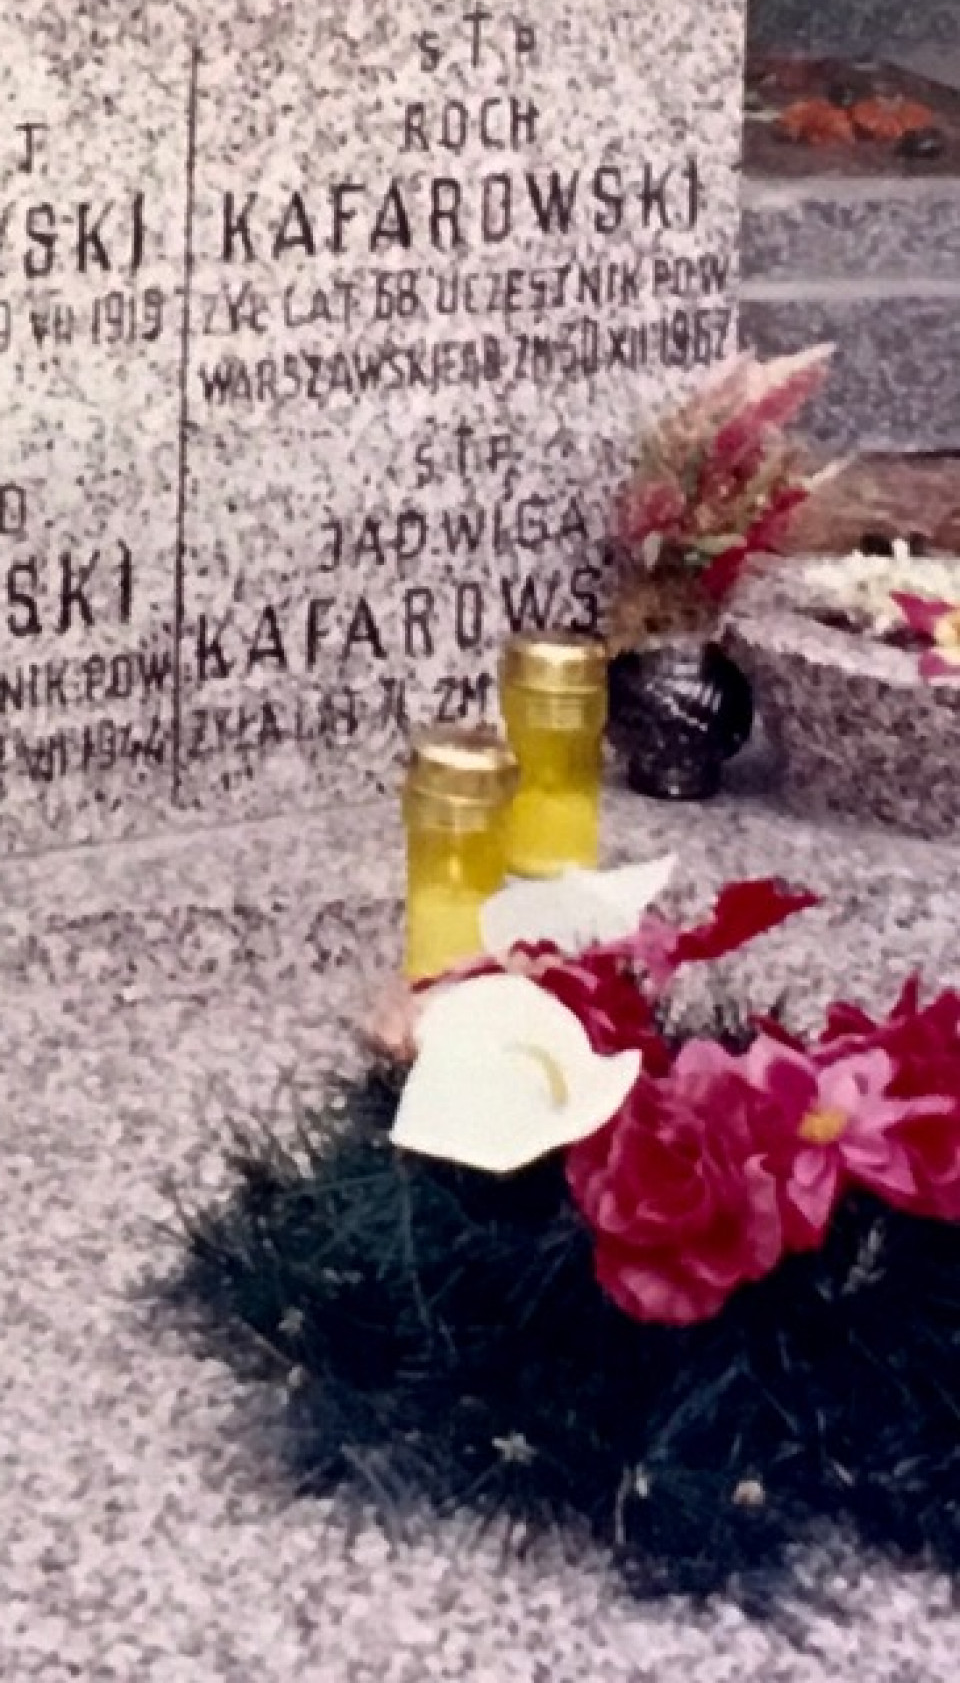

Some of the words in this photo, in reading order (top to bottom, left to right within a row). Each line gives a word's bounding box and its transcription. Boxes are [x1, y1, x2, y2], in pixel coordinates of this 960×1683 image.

[400, 97, 540, 153] ROCH
[219, 156, 703, 264] KAFAROWSKI
[92, 284, 163, 347] 1919
[284, 278, 357, 334] LAT
[372, 267, 420, 321] 68
[435, 258, 640, 318] UCZESTNIK
[651, 251, 731, 302] POW
[198, 331, 502, 402] WARSZAWSKIEGO
[319, 496, 589, 574] JADWIGA
[195, 564, 602, 682] KAFAROWS
[83, 653, 171, 704] POW
[431, 672, 493, 723] ZM
[83, 712, 170, 773] 1944
